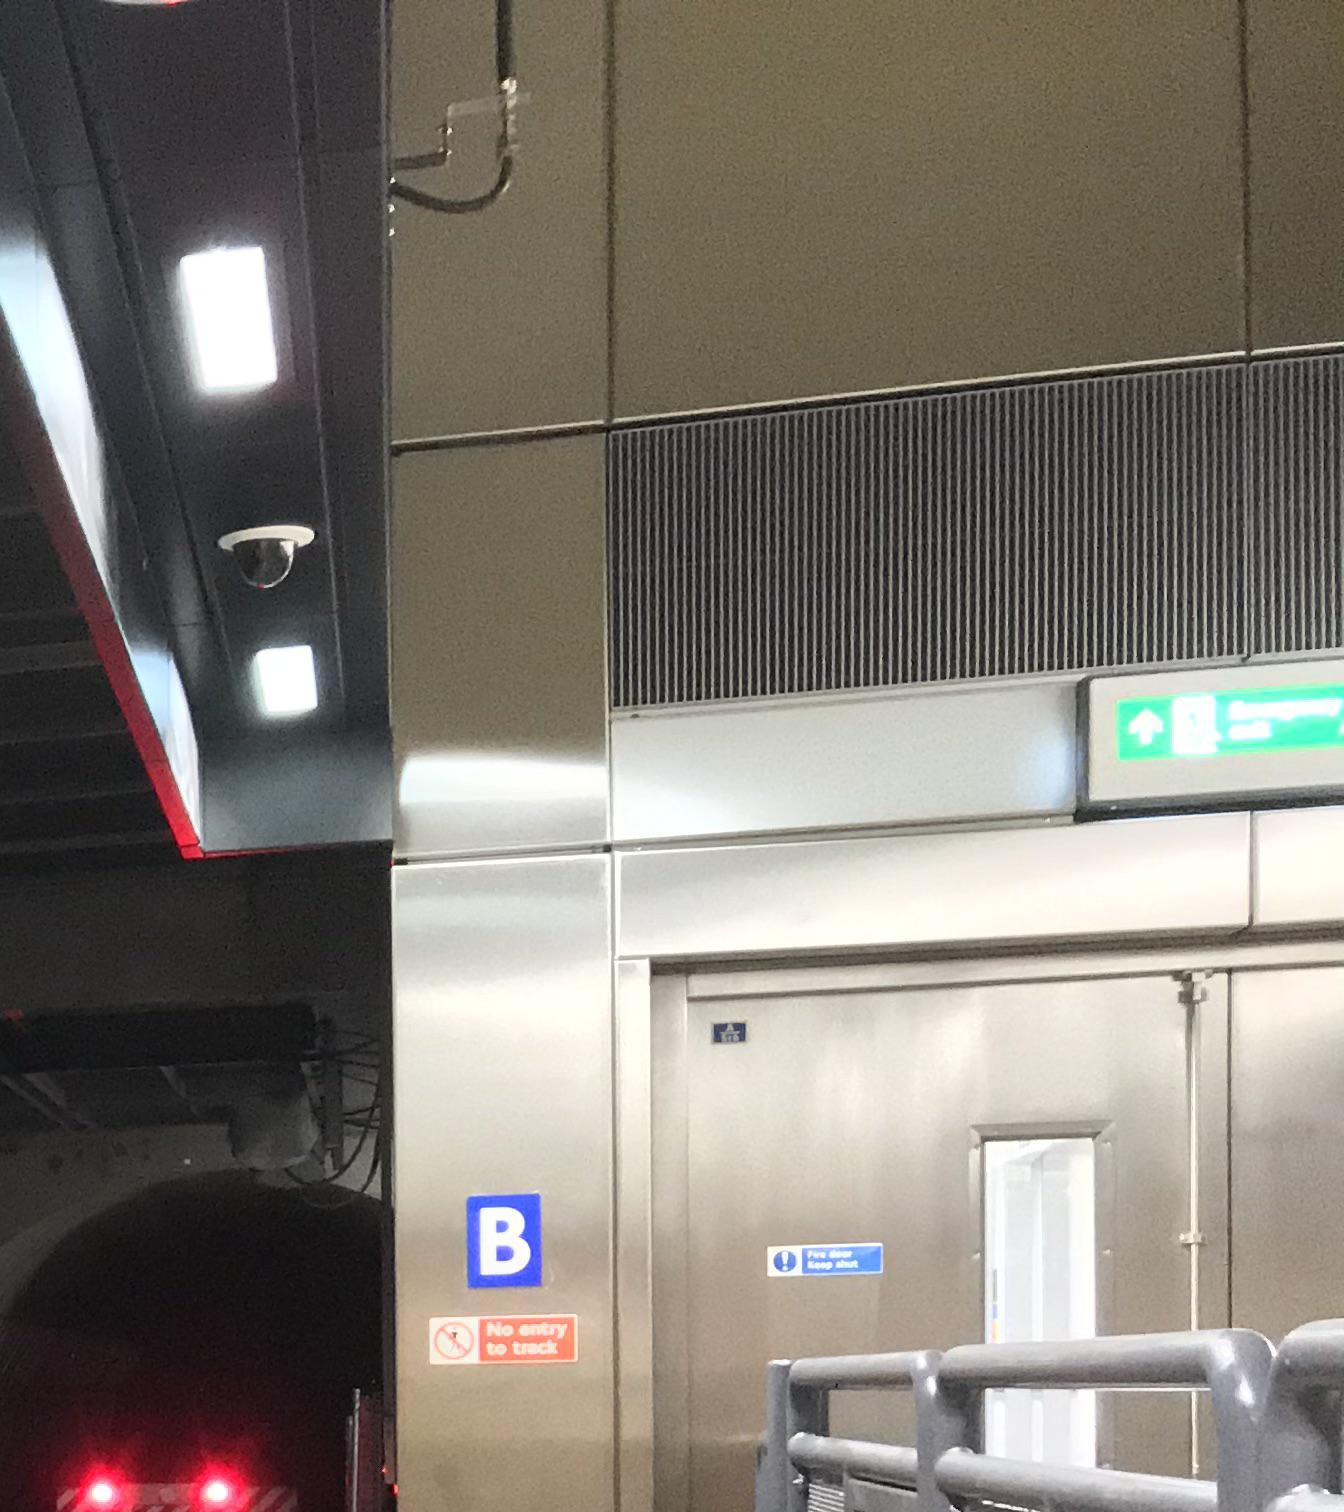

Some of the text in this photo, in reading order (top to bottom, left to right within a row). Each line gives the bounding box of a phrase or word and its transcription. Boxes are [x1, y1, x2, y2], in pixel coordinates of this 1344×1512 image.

[479, 1206, 532, 1276] B
[486, 1321, 569, 1340] No entry
[485, 1339, 559, 1357] to track
